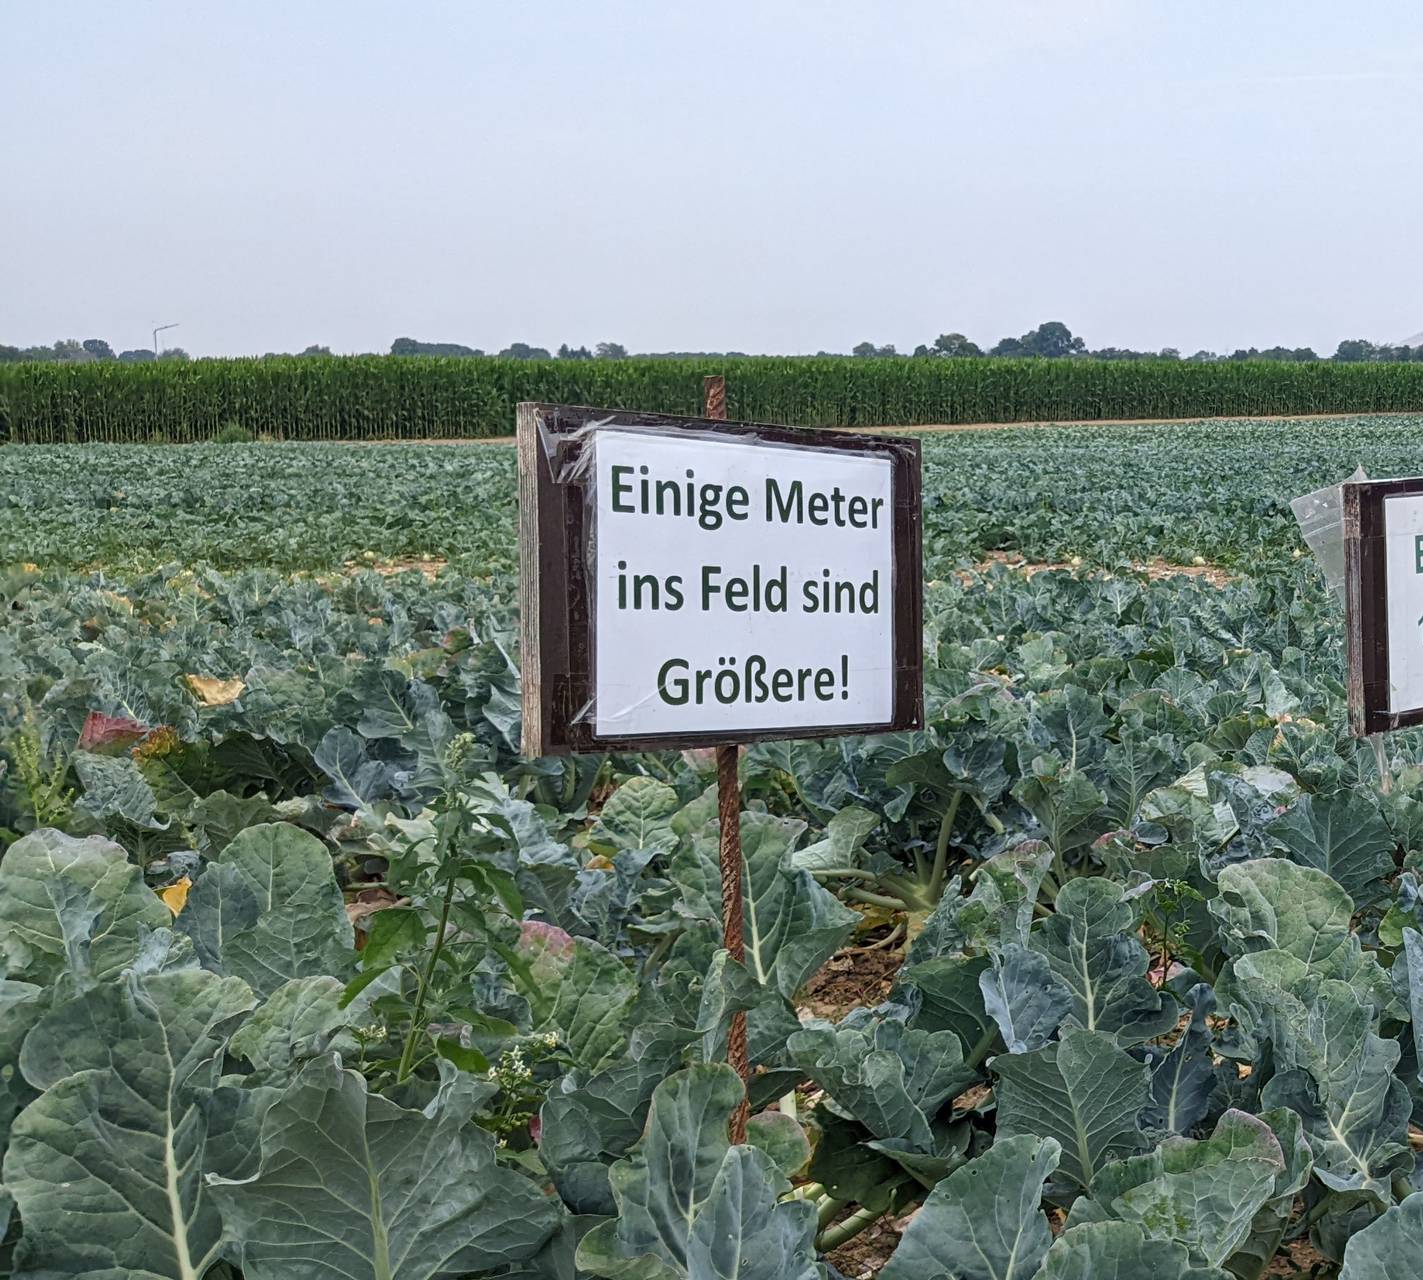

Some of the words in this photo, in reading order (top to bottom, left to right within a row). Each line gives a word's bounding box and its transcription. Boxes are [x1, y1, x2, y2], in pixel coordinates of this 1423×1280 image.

[611, 464, 750, 531] Einige
[765, 477, 884, 530] Meter
[617, 560, 685, 611] ins
[701, 564, 788, 613] Feld
[802, 569, 879, 615] sind
[657, 654, 849, 706] Größere!
